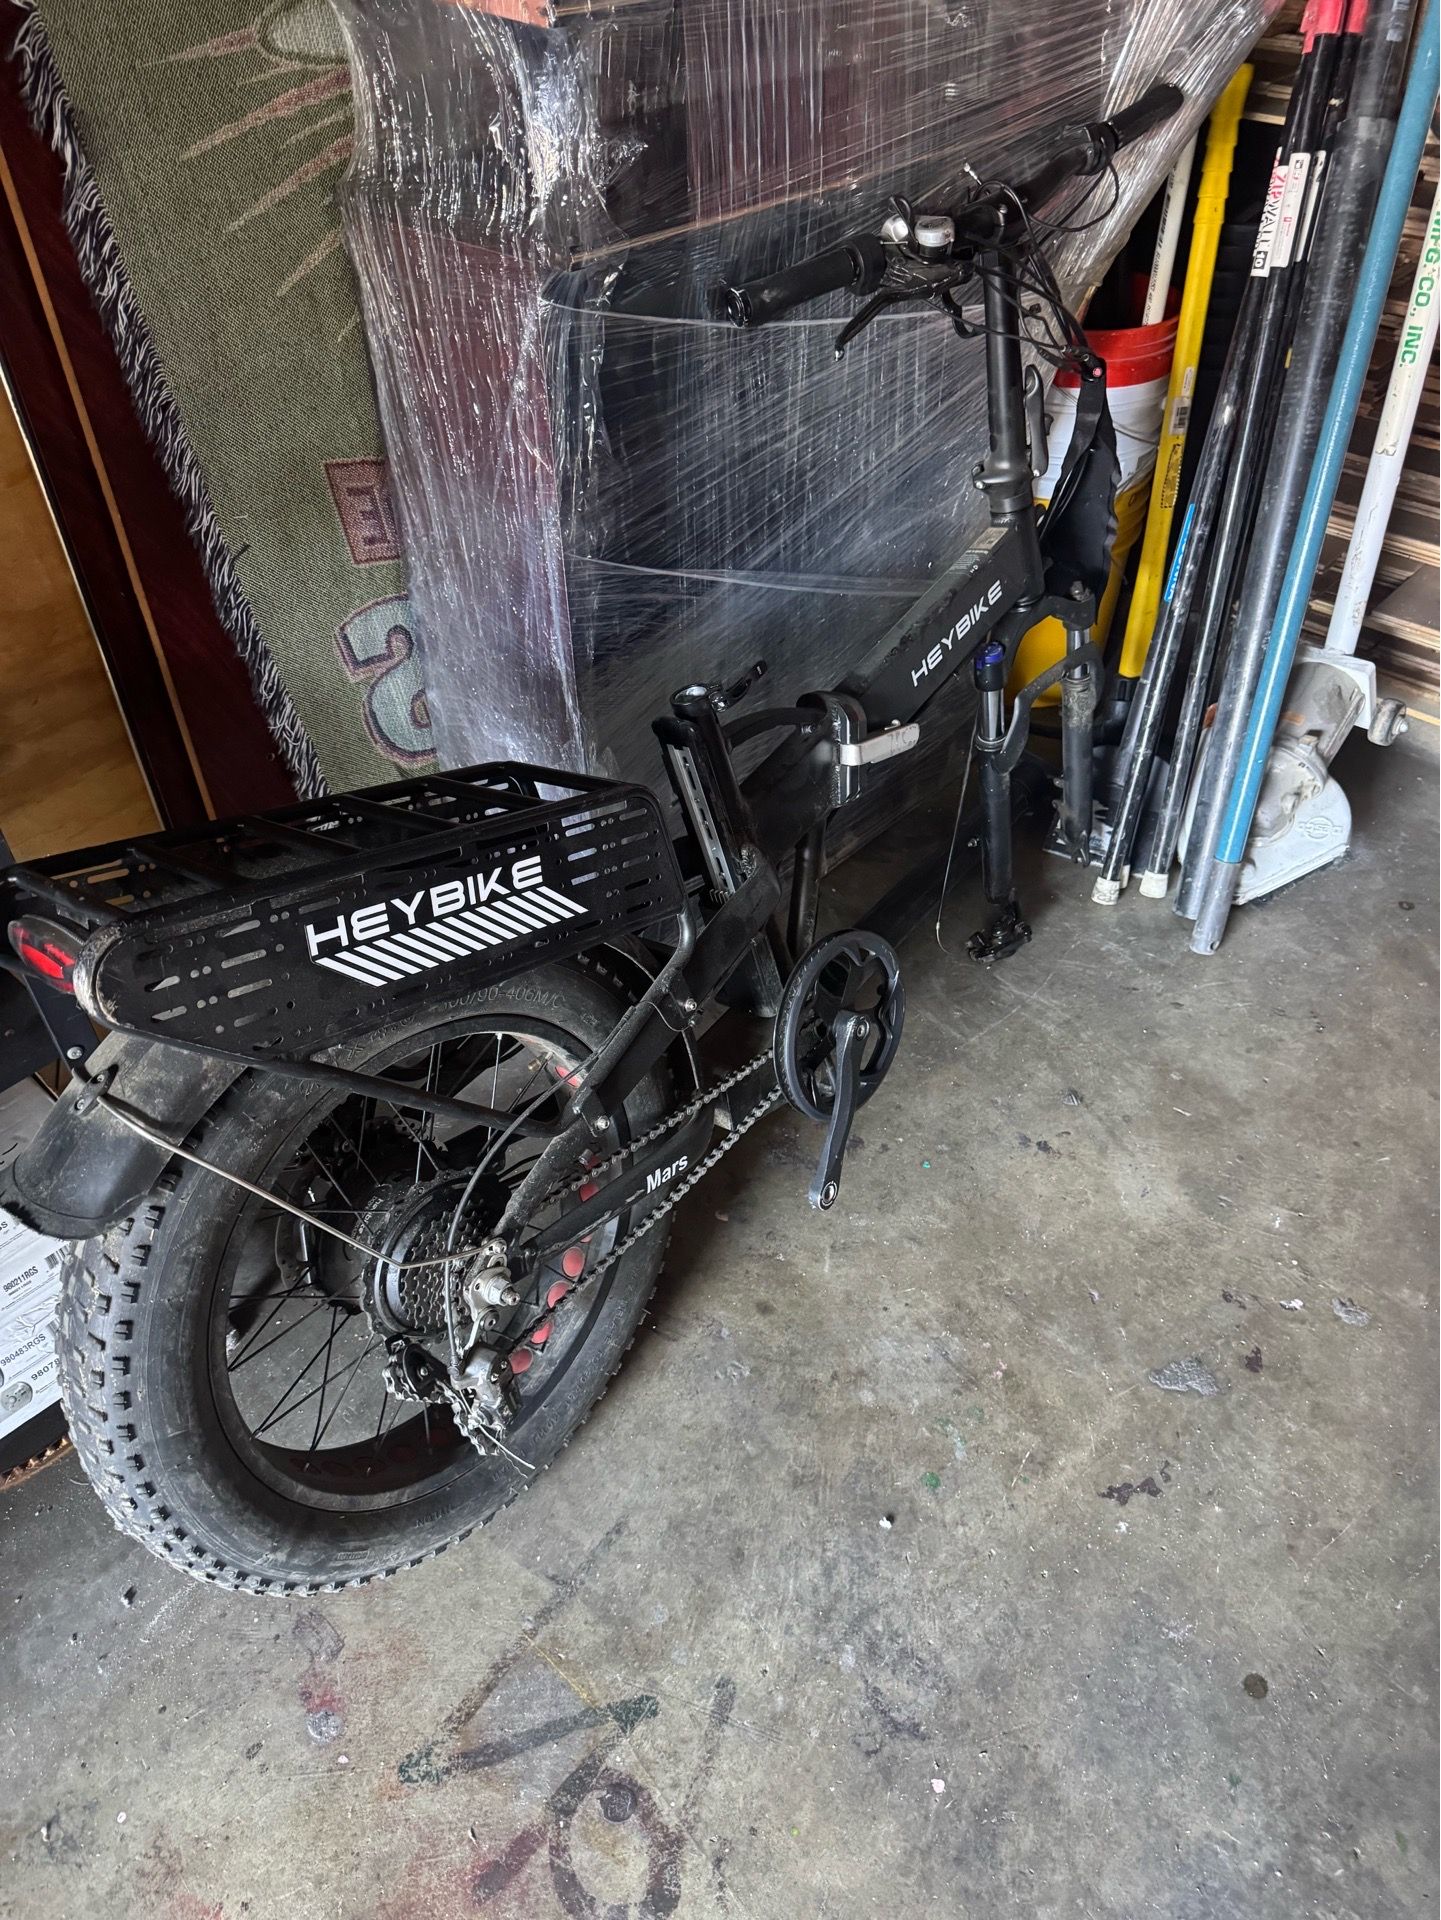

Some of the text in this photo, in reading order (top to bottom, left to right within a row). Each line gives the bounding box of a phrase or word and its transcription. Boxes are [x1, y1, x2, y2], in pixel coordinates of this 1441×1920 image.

[1410, 276, 1434, 316] CO.,
[1399, 325, 1423, 367] INC.
[911, 579, 1003, 688] HEYBIKE
[306, 856, 543, 957] HEYBIKE
[646, 1155, 688, 1193] Mars
[0, 1333, 46, 1366] 980483RGS
